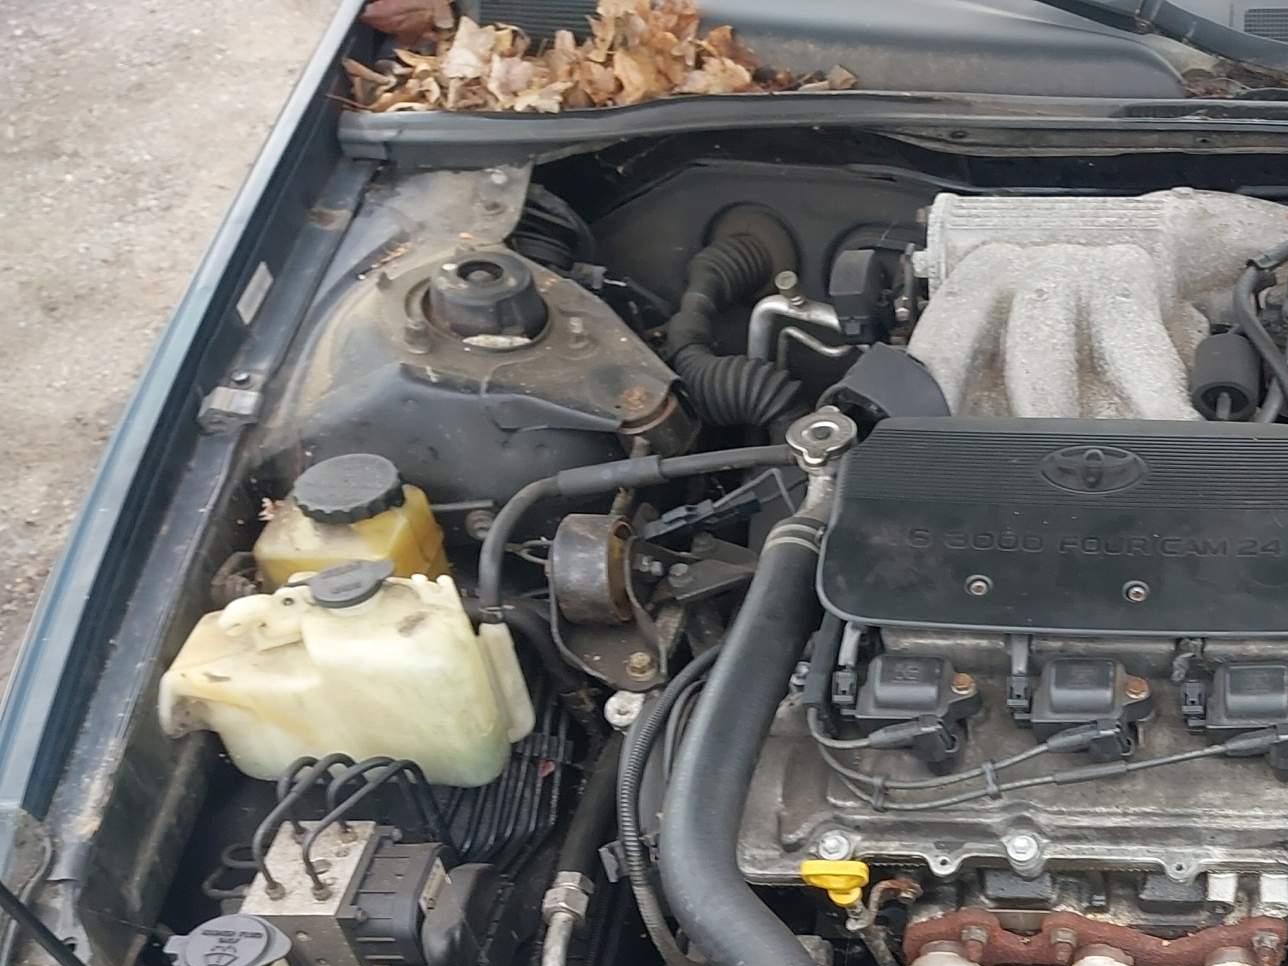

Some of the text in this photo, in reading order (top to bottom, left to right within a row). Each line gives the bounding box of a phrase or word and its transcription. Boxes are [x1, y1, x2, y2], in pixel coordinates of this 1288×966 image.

[1057, 534, 1152, 558] FOUR
[1159, 536, 1229, 558] CAM
[1233, 536, 1283, 559] 24
